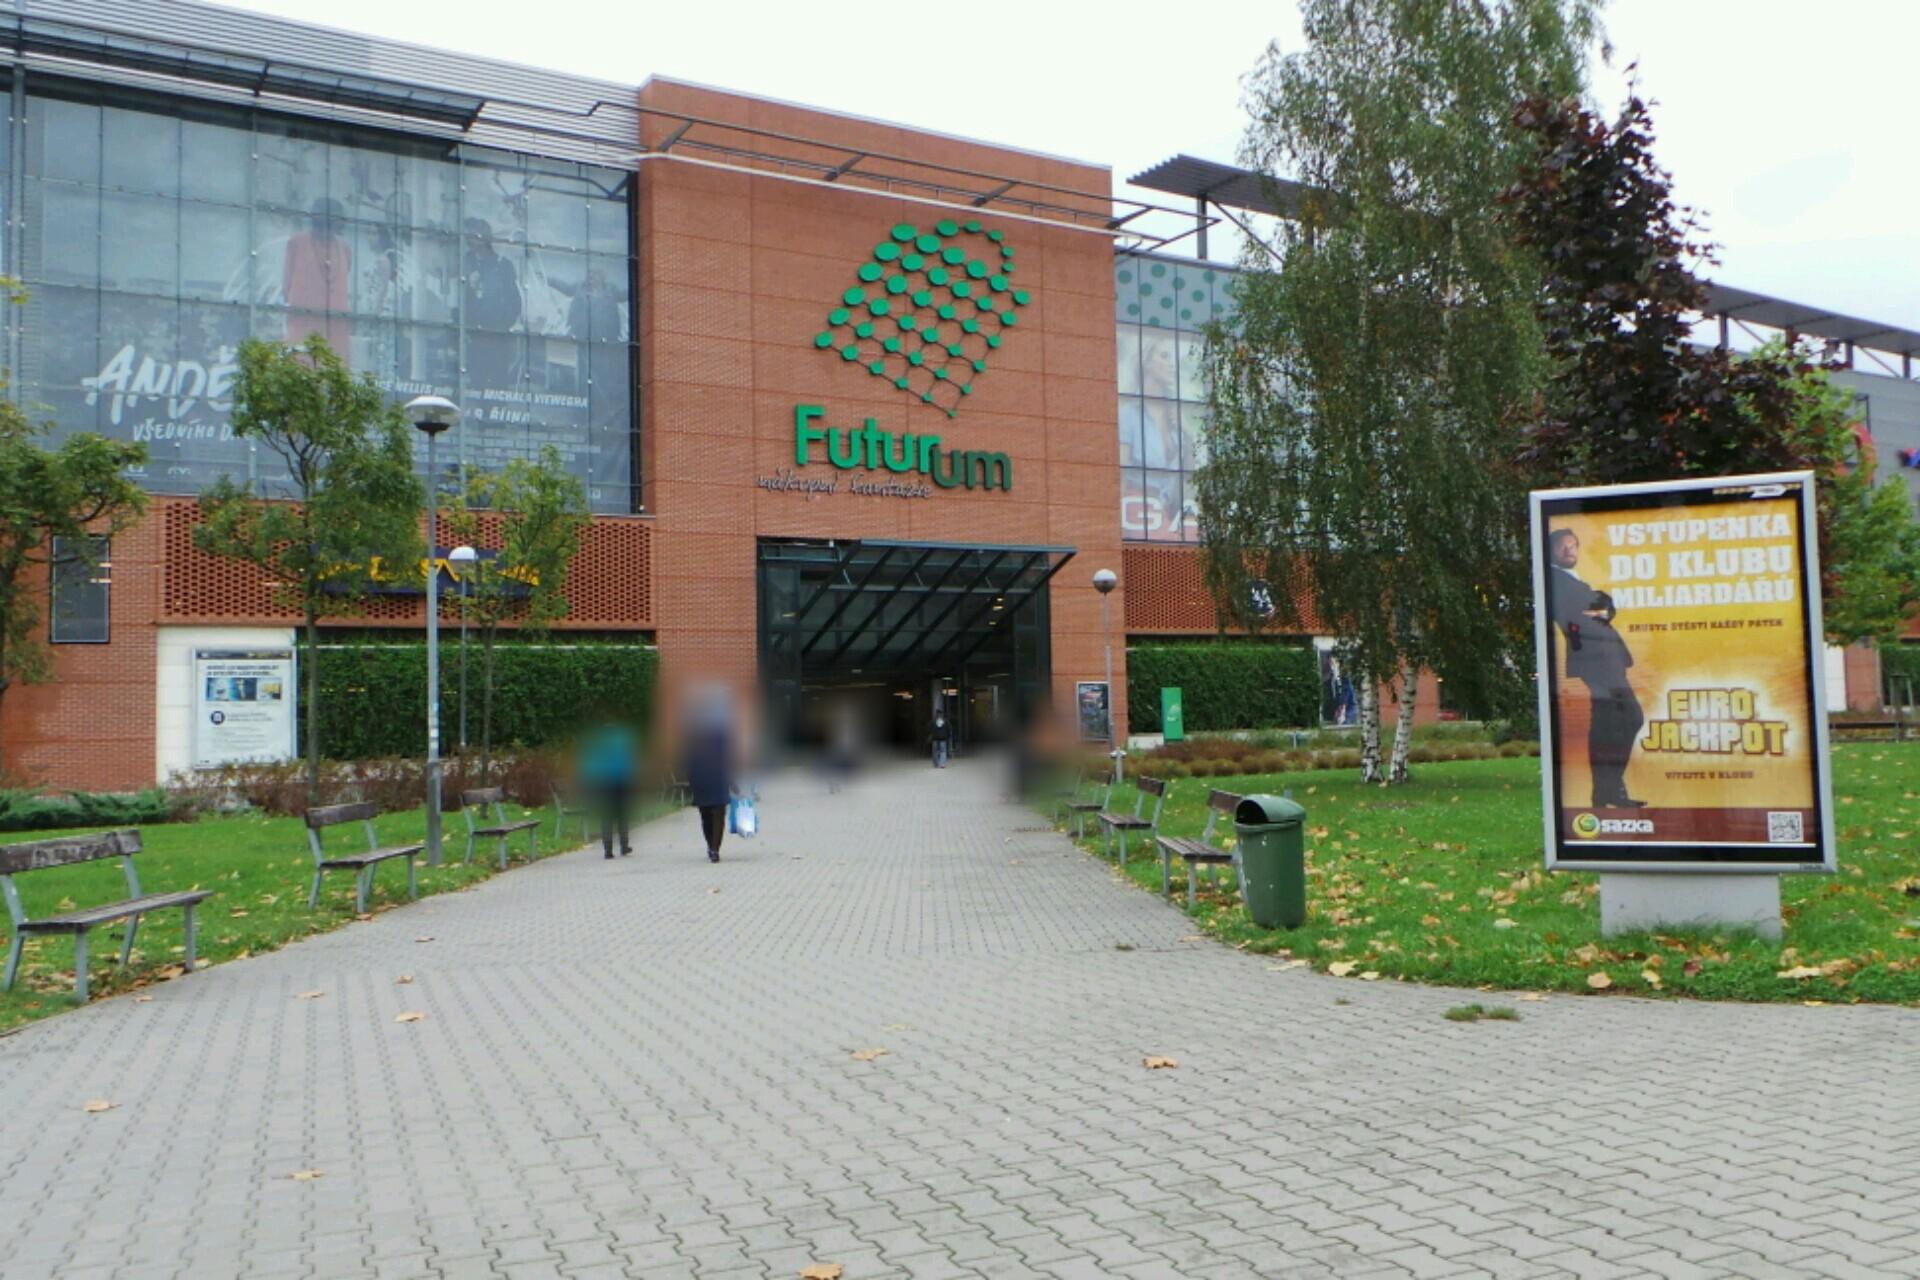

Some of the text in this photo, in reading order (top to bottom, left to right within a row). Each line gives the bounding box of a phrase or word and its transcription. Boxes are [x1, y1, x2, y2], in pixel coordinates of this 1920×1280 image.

[81, 344, 242, 425] ANDĚ
[794, 403, 1012, 491] Futurum
[1121, 496, 1199, 532] GA
[1608, 513, 1792, 546] VSTUPENKA
[1609, 545, 1792, 581] DO KLUBU
[1611, 574, 1794, 609] MILIARDÁŘŮ
[1669, 689, 1755, 720] EURO
[1641, 720, 1787, 755] JACKPOT
[1600, 818, 1654, 834] sazka
